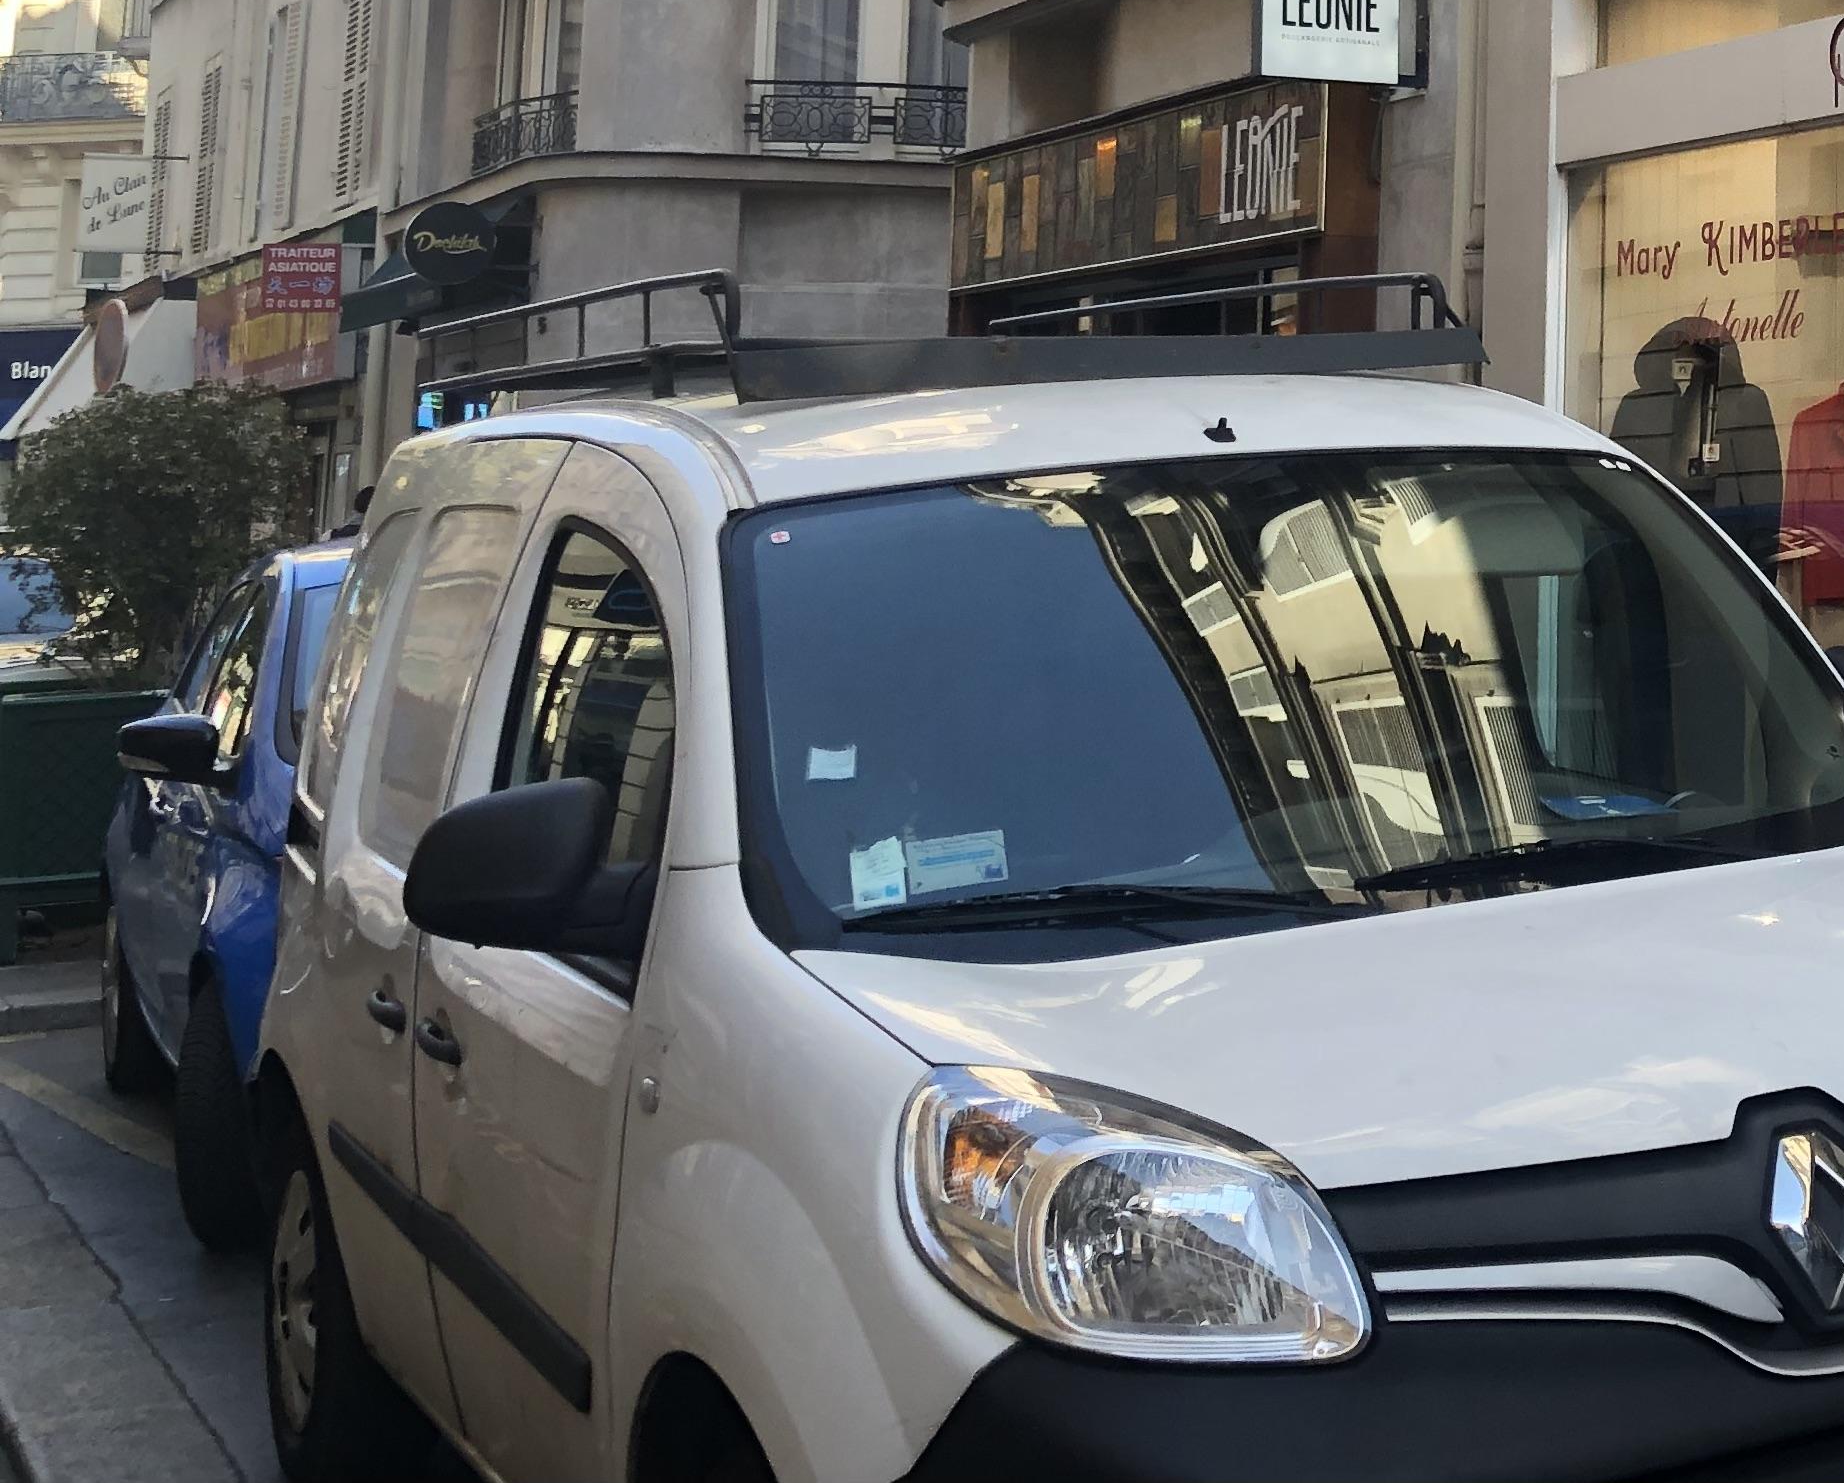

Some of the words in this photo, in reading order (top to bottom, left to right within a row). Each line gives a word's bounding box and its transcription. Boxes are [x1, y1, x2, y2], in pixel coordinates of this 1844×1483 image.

[82, 186, 110, 211] Au
[113, 175, 147, 196] Clair
[87, 216, 102, 235] de
[106, 200, 146, 225] Lune
[268, 247, 336, 259] TRAITEUR
[268, 261, 337, 273] ASIATIQUE
[1616, 238, 1681, 280] Mary
[1673, 288, 1805, 346] Atonelle
